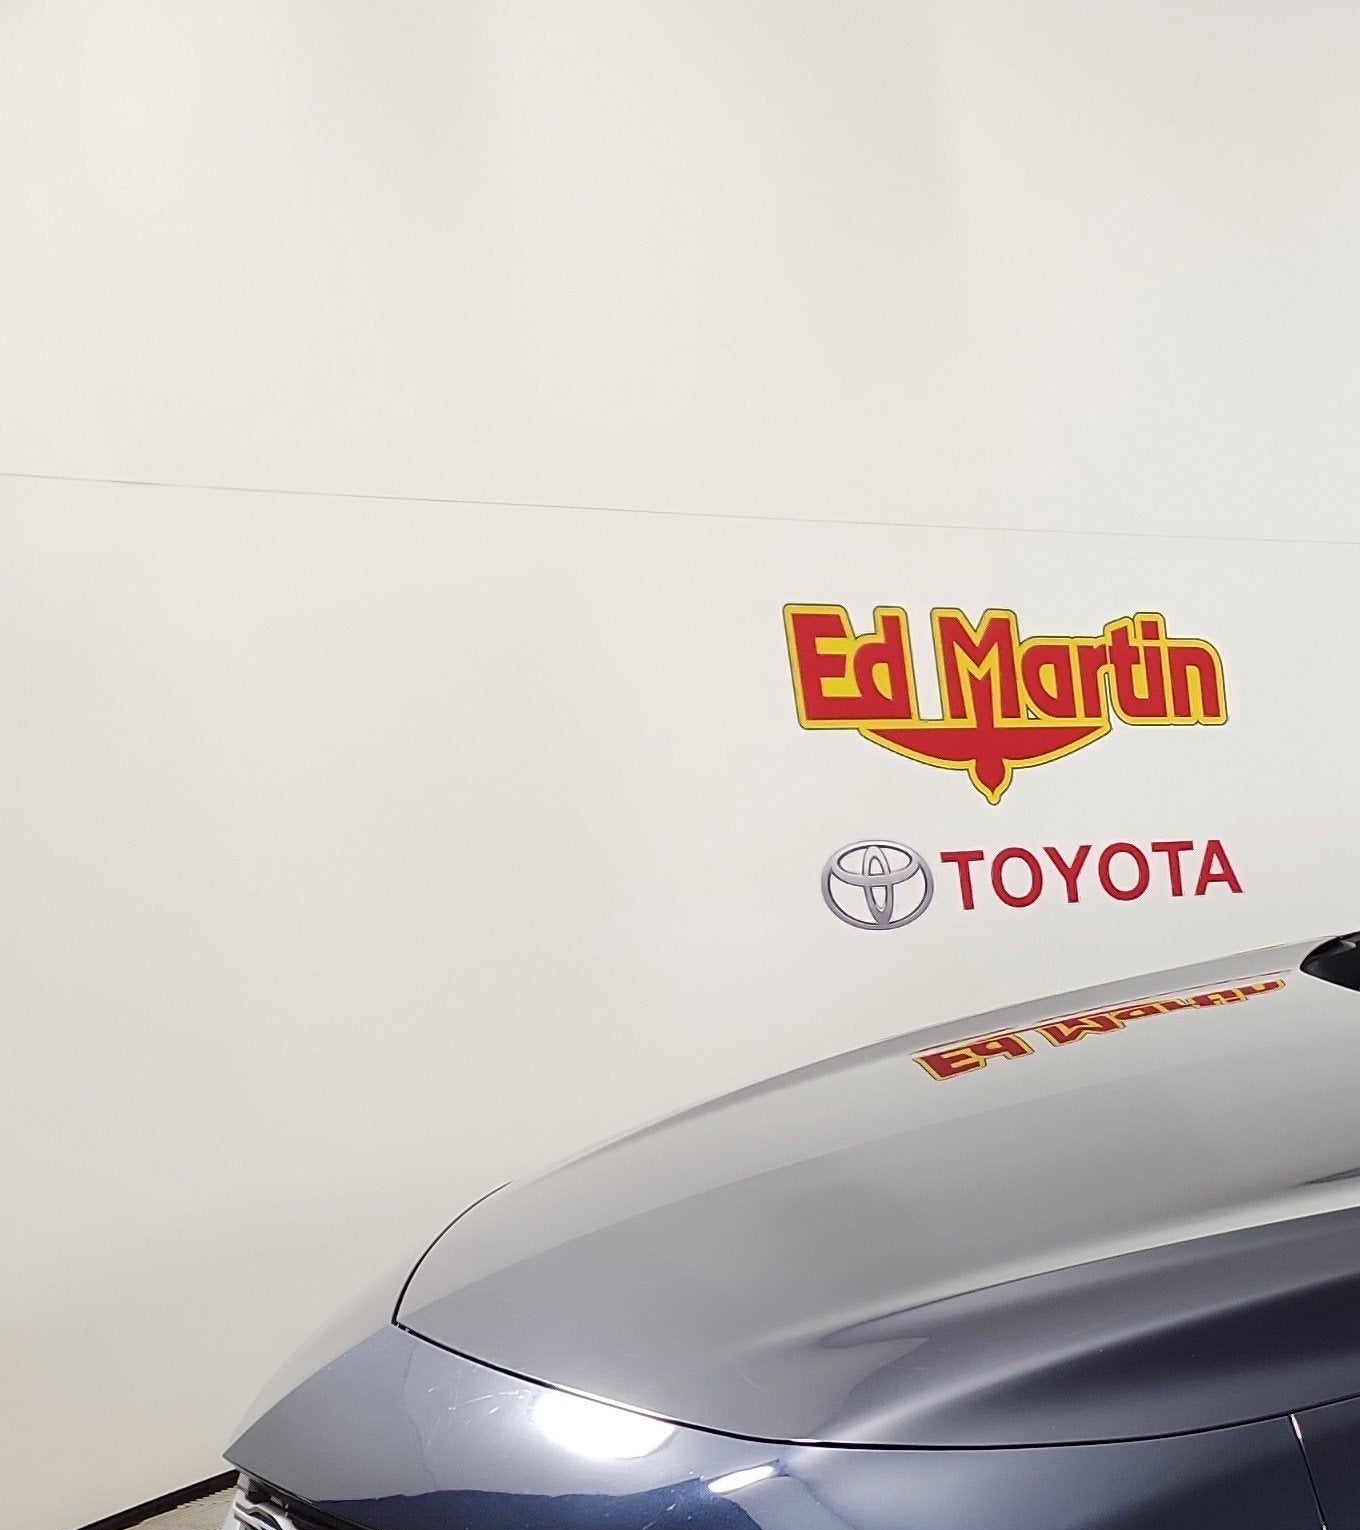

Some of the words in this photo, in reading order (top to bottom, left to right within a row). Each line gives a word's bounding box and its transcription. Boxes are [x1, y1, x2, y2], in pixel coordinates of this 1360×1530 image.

[784, 604, 919, 728] Ed
[931, 608, 1227, 725] Martin
[940, 840, 1243, 911] TOYOTA
